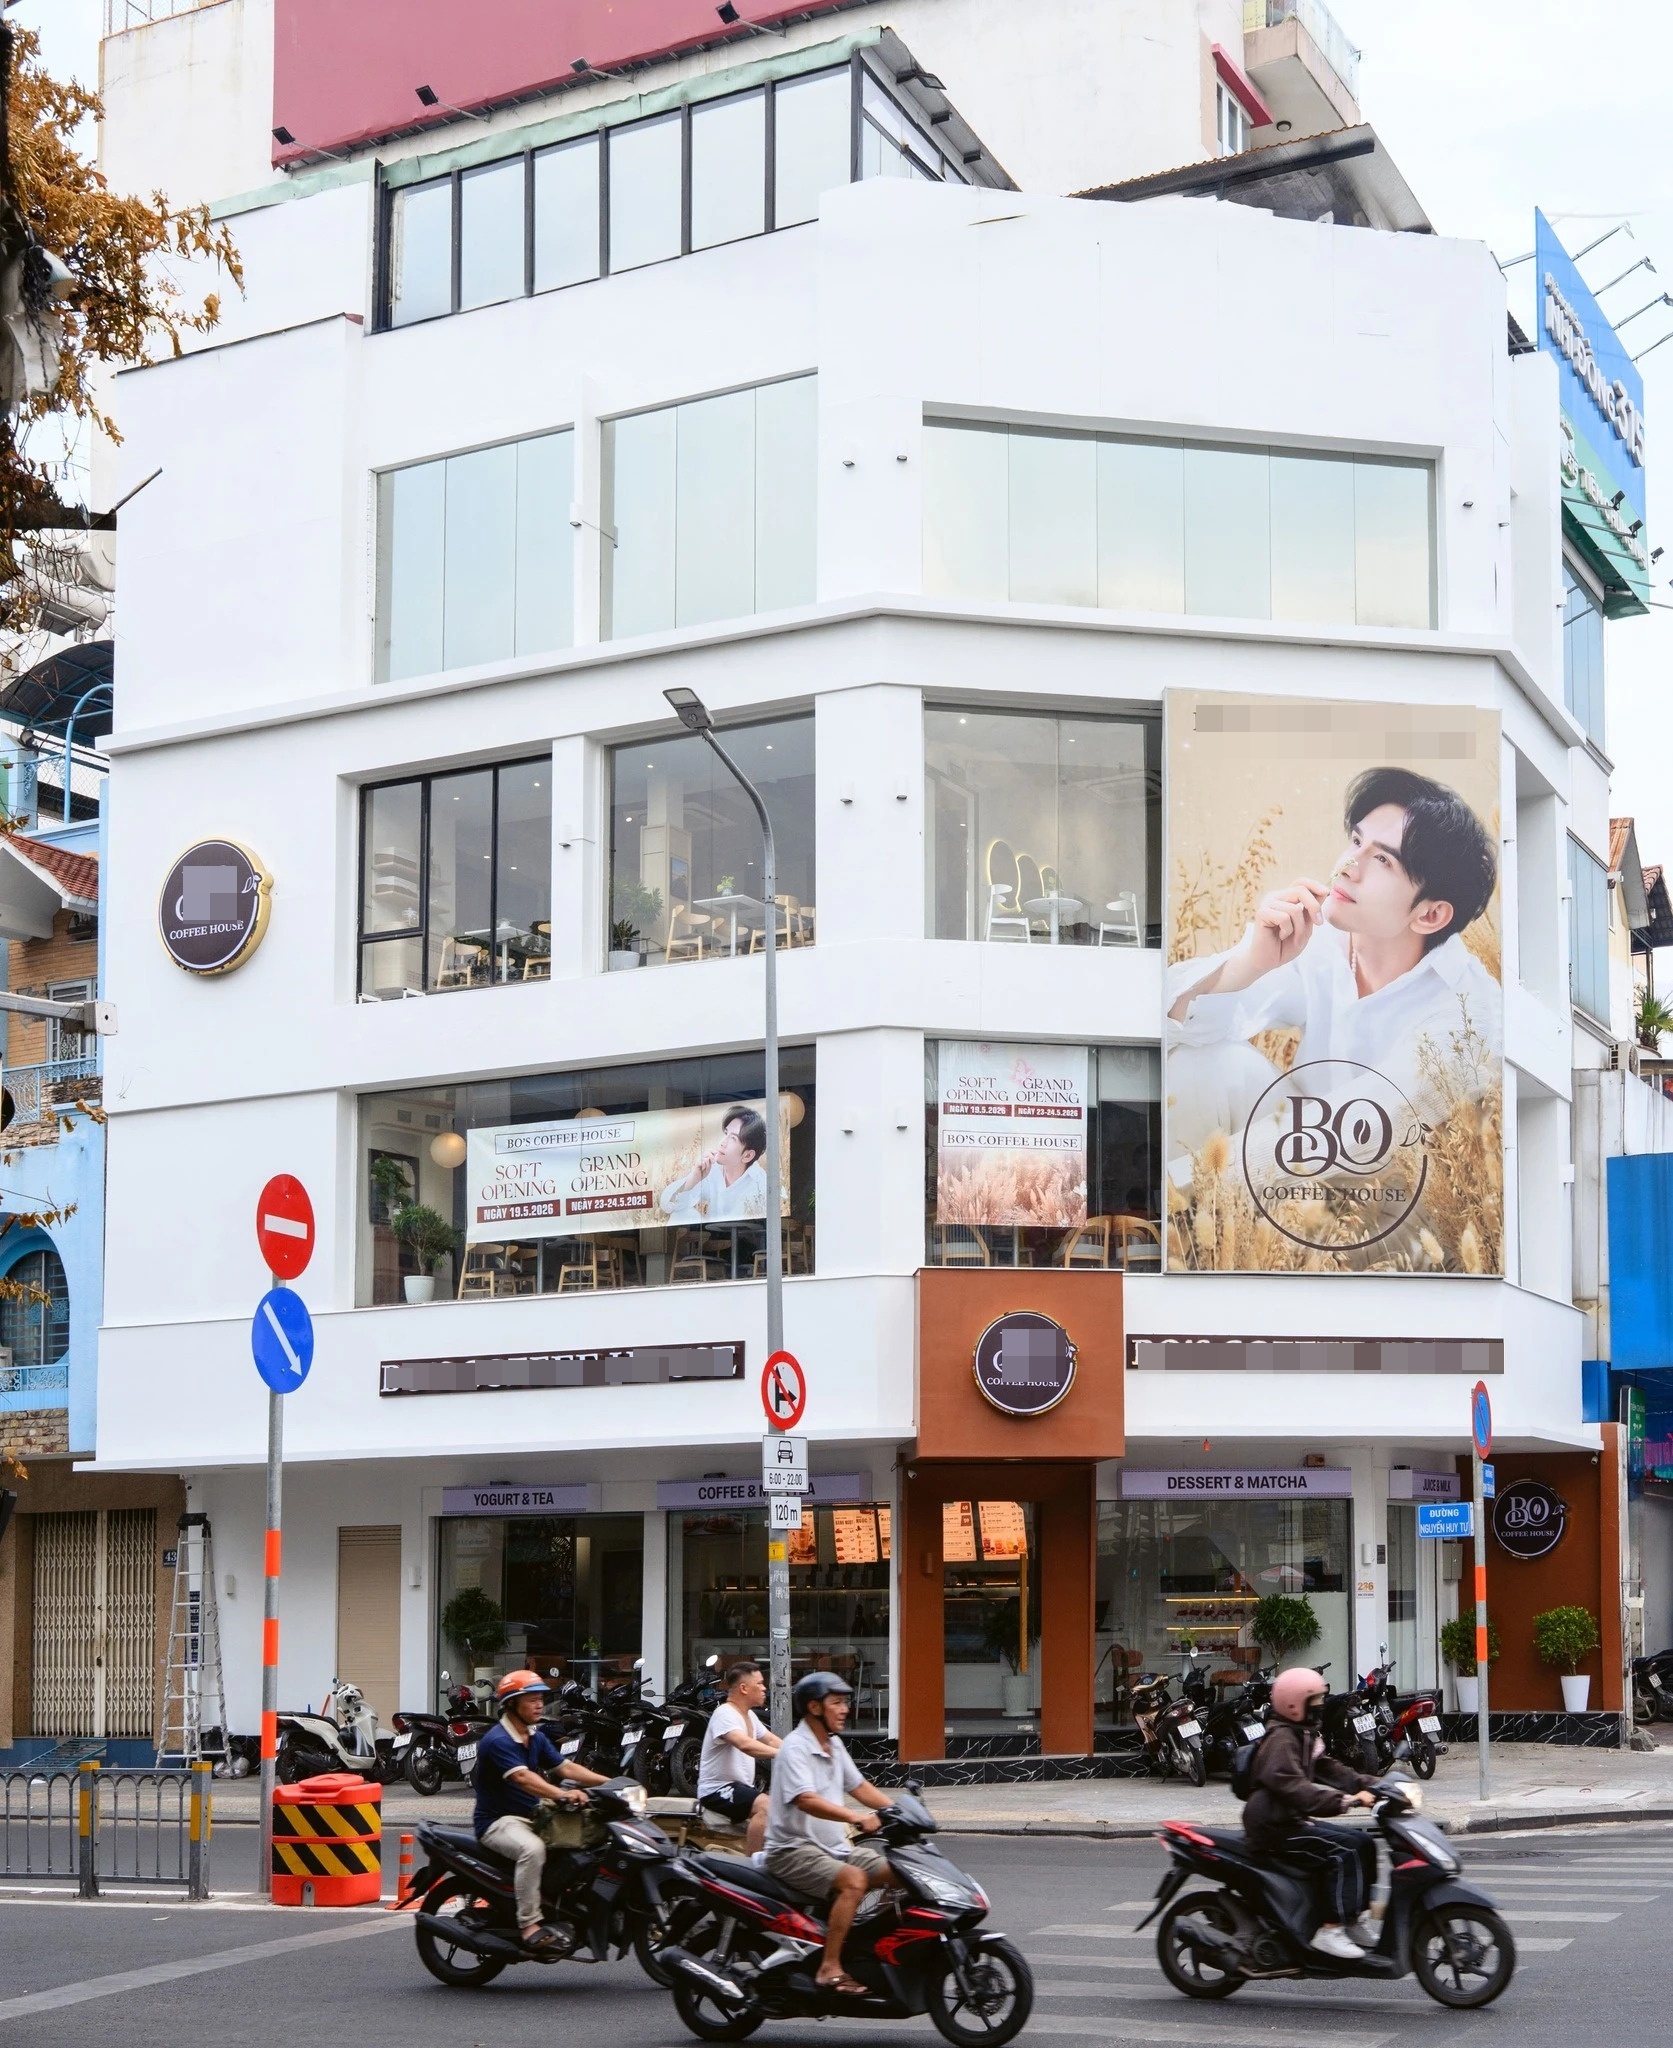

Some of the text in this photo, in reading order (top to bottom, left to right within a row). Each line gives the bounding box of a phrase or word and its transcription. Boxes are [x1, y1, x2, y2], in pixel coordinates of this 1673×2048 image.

[1545, 295, 1573, 360] NHI
[1573, 337, 1615, 422] ĐỒNG
[1612, 380, 1645, 468] 315
[170, 921, 244, 940] COFFEE HOUSE
[959, 1076, 997, 1089] SOFT
[1022, 1077, 1073, 1091] GRAND
[946, 1089, 1009, 1102] OPENING
[1016, 1091, 1079, 1104] OPENING
[949, 1104, 1006, 1115] NGÀY 19.5.2026
[1018, 1107, 1078, 1117] NGÀY 23-24.5.2026
[533, 1133, 578, 1146] COFFEE
[581, 1128, 621, 1141] HOUSE
[978, 1136, 1030, 1147] COFFEE
[1033, 1137, 1078, 1148] HOUSE
[1274, 1096, 1393, 1177] BO
[579, 1152, 641, 1173] GRAND
[495, 1162, 542, 1181] SOFT
[570, 1170, 648, 1192] OPENING
[481, 1179, 556, 1201] OPENING
[1263, 1186, 1407, 1202] COFFEE HOUSE
[571, 1194, 647, 1212] NGÀY 23-24.5.2026
[483, 1203, 554, 1221] NGÀY 19.5.2026
[769, 1472, 781, 1485] 6:00
[786, 1473, 803, 1486] 22:00
[1167, 1475, 1308, 1489] DESSERT & MATCHA
[1423, 1479, 1436, 1491] JUICE
[1440, 1480, 1451, 1492] MILK
[474, 1492, 554, 1506] YOGURT & TEA
[698, 1485, 745, 1500] COFFEE
[747, 1484, 756, 1498] &
[775, 1505, 798, 1521] 120 m
[1429, 1508, 1460, 1518] ĐƯỜNG
[1505, 1496, 1549, 1529] BO
[1445, 1522, 1458, 1533] HUY
[165, 1551, 177, 1562] 43
